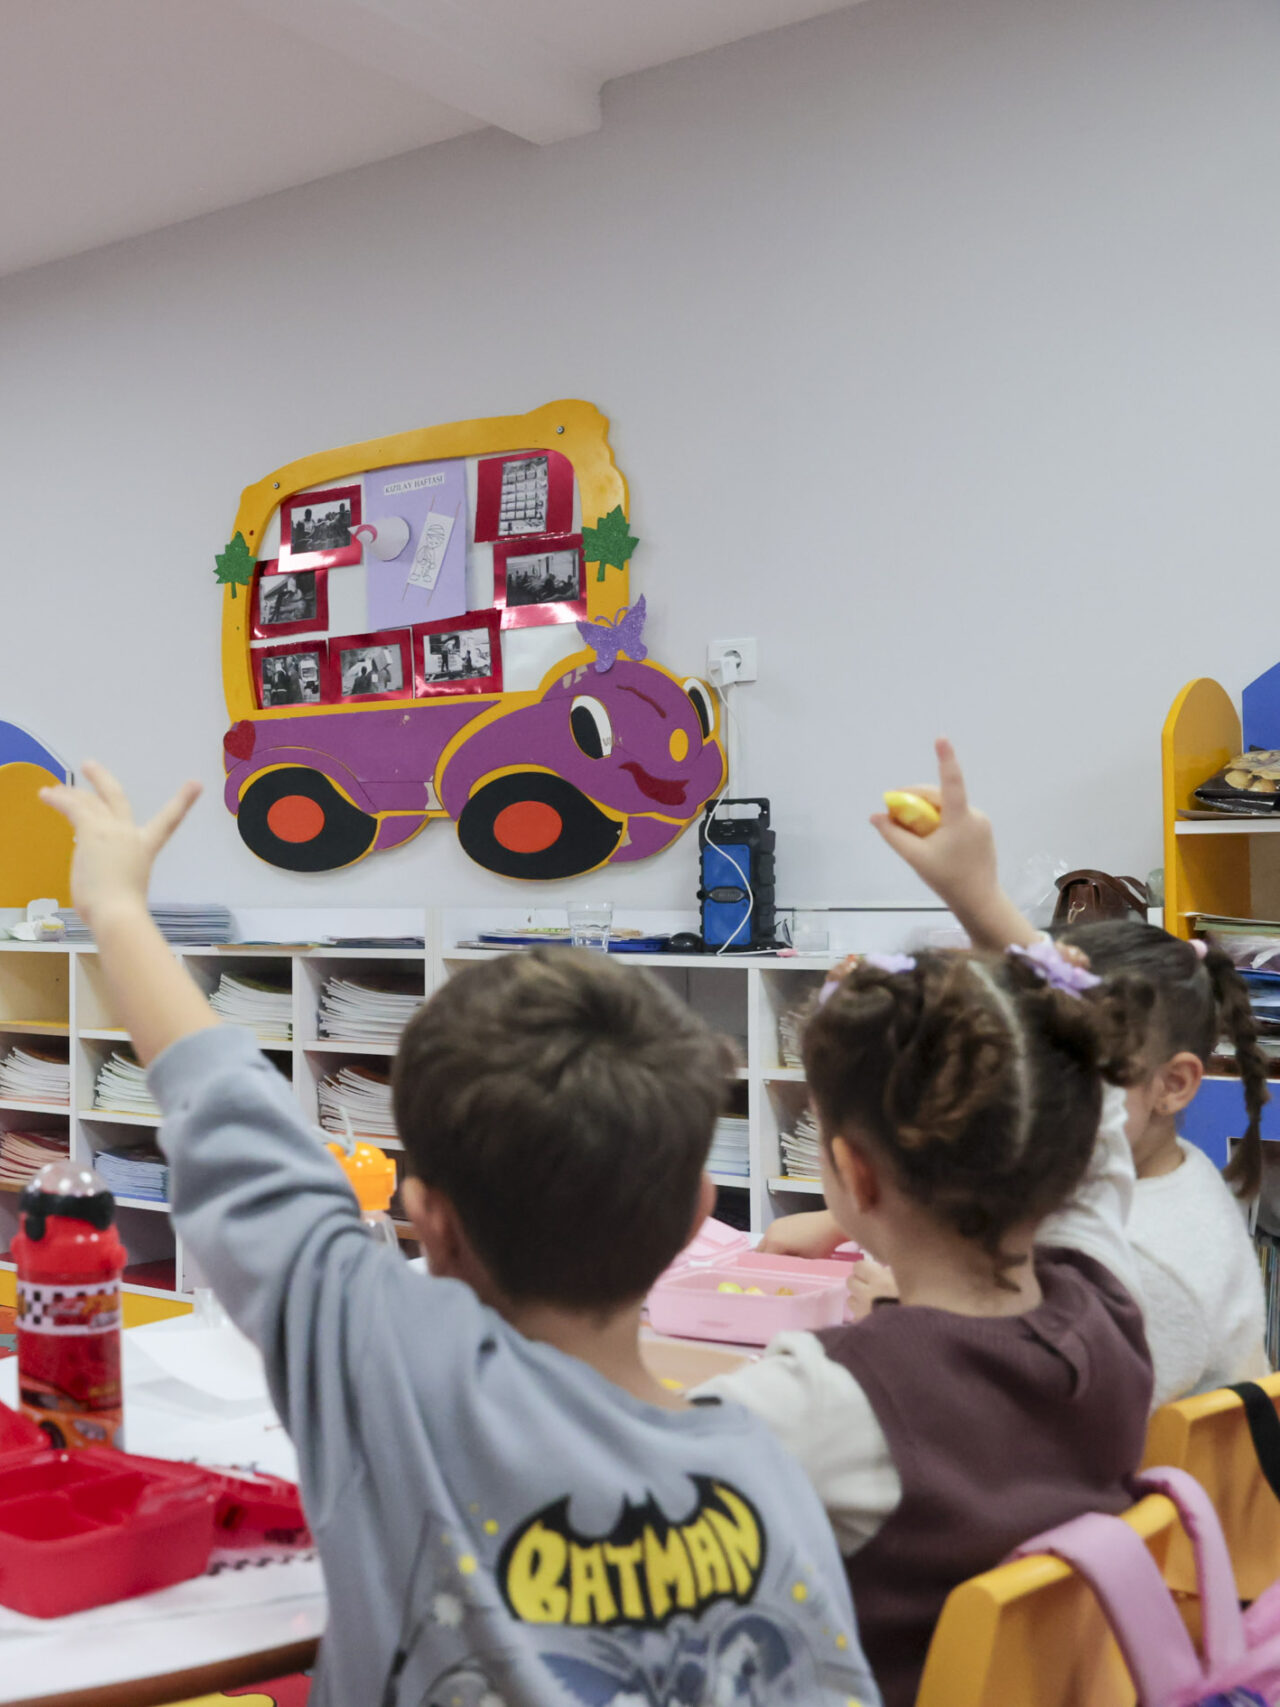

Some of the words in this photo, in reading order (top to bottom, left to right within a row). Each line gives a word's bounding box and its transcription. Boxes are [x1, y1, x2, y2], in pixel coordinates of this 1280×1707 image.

[385, 482, 412, 493] KIZILAY
[414, 475, 443, 488] HAFTASI
[507, 1479, 761, 1625] BATMAN
